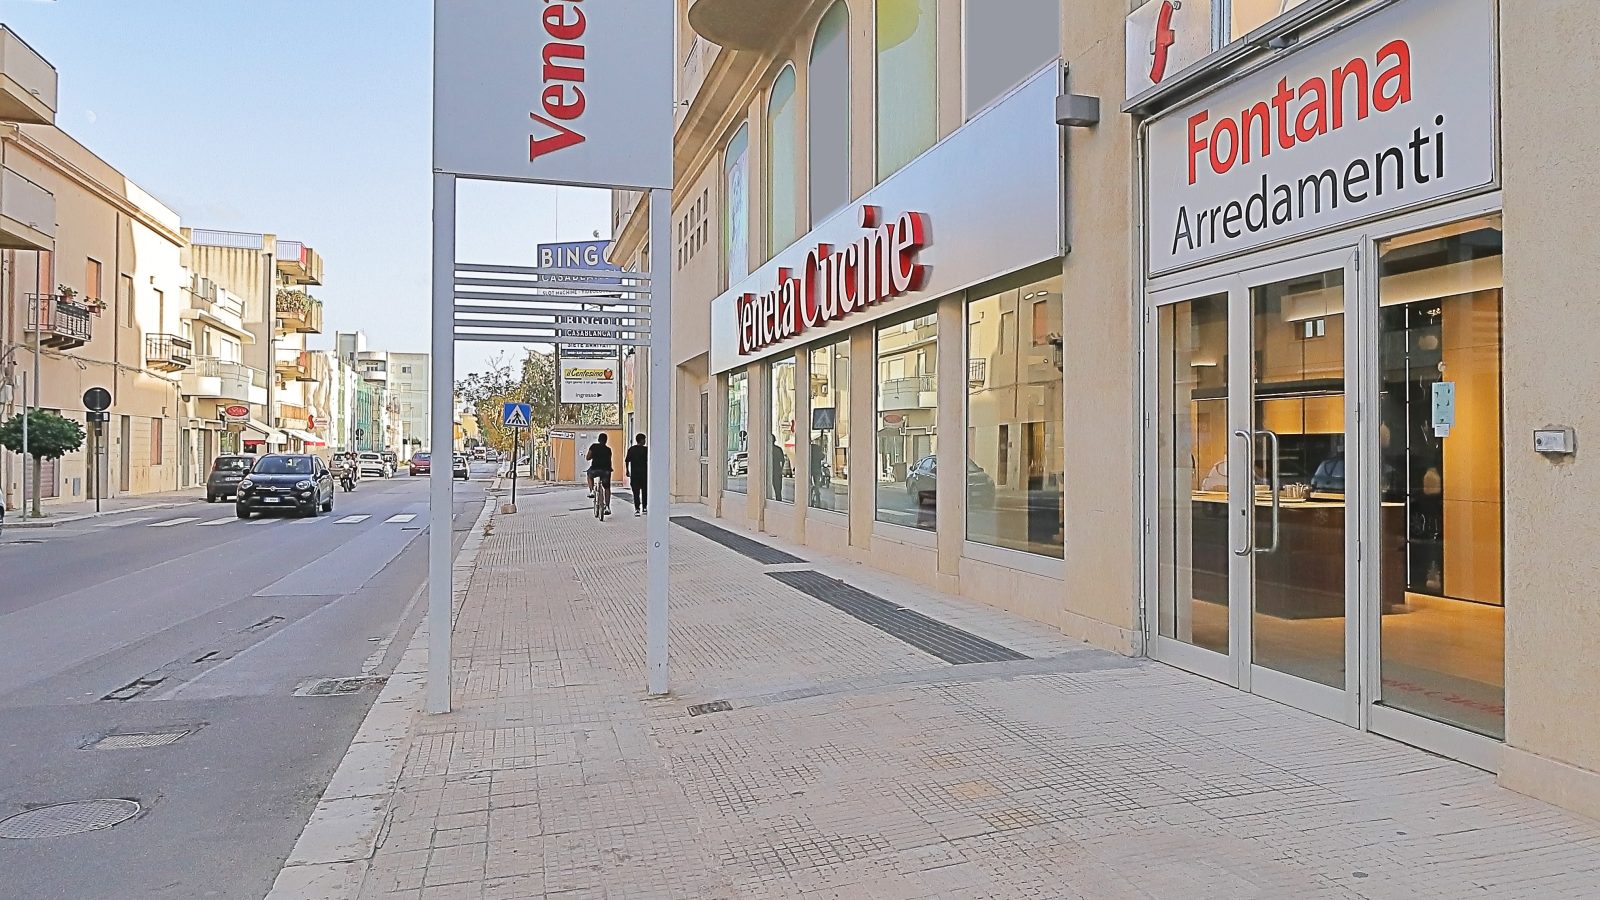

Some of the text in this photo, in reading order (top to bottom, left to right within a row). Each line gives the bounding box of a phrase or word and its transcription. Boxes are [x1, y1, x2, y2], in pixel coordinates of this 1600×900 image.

[529, 0, 586, 162] Vene
[1186, 38, 1413, 185] Fontana
[1171, 113, 1446, 256] Arredamenti
[736, 204, 926, 355] Veneta Cucine
[571, 367, 603, 378] Centesimo
[575, 392, 597, 400] Ingresso
